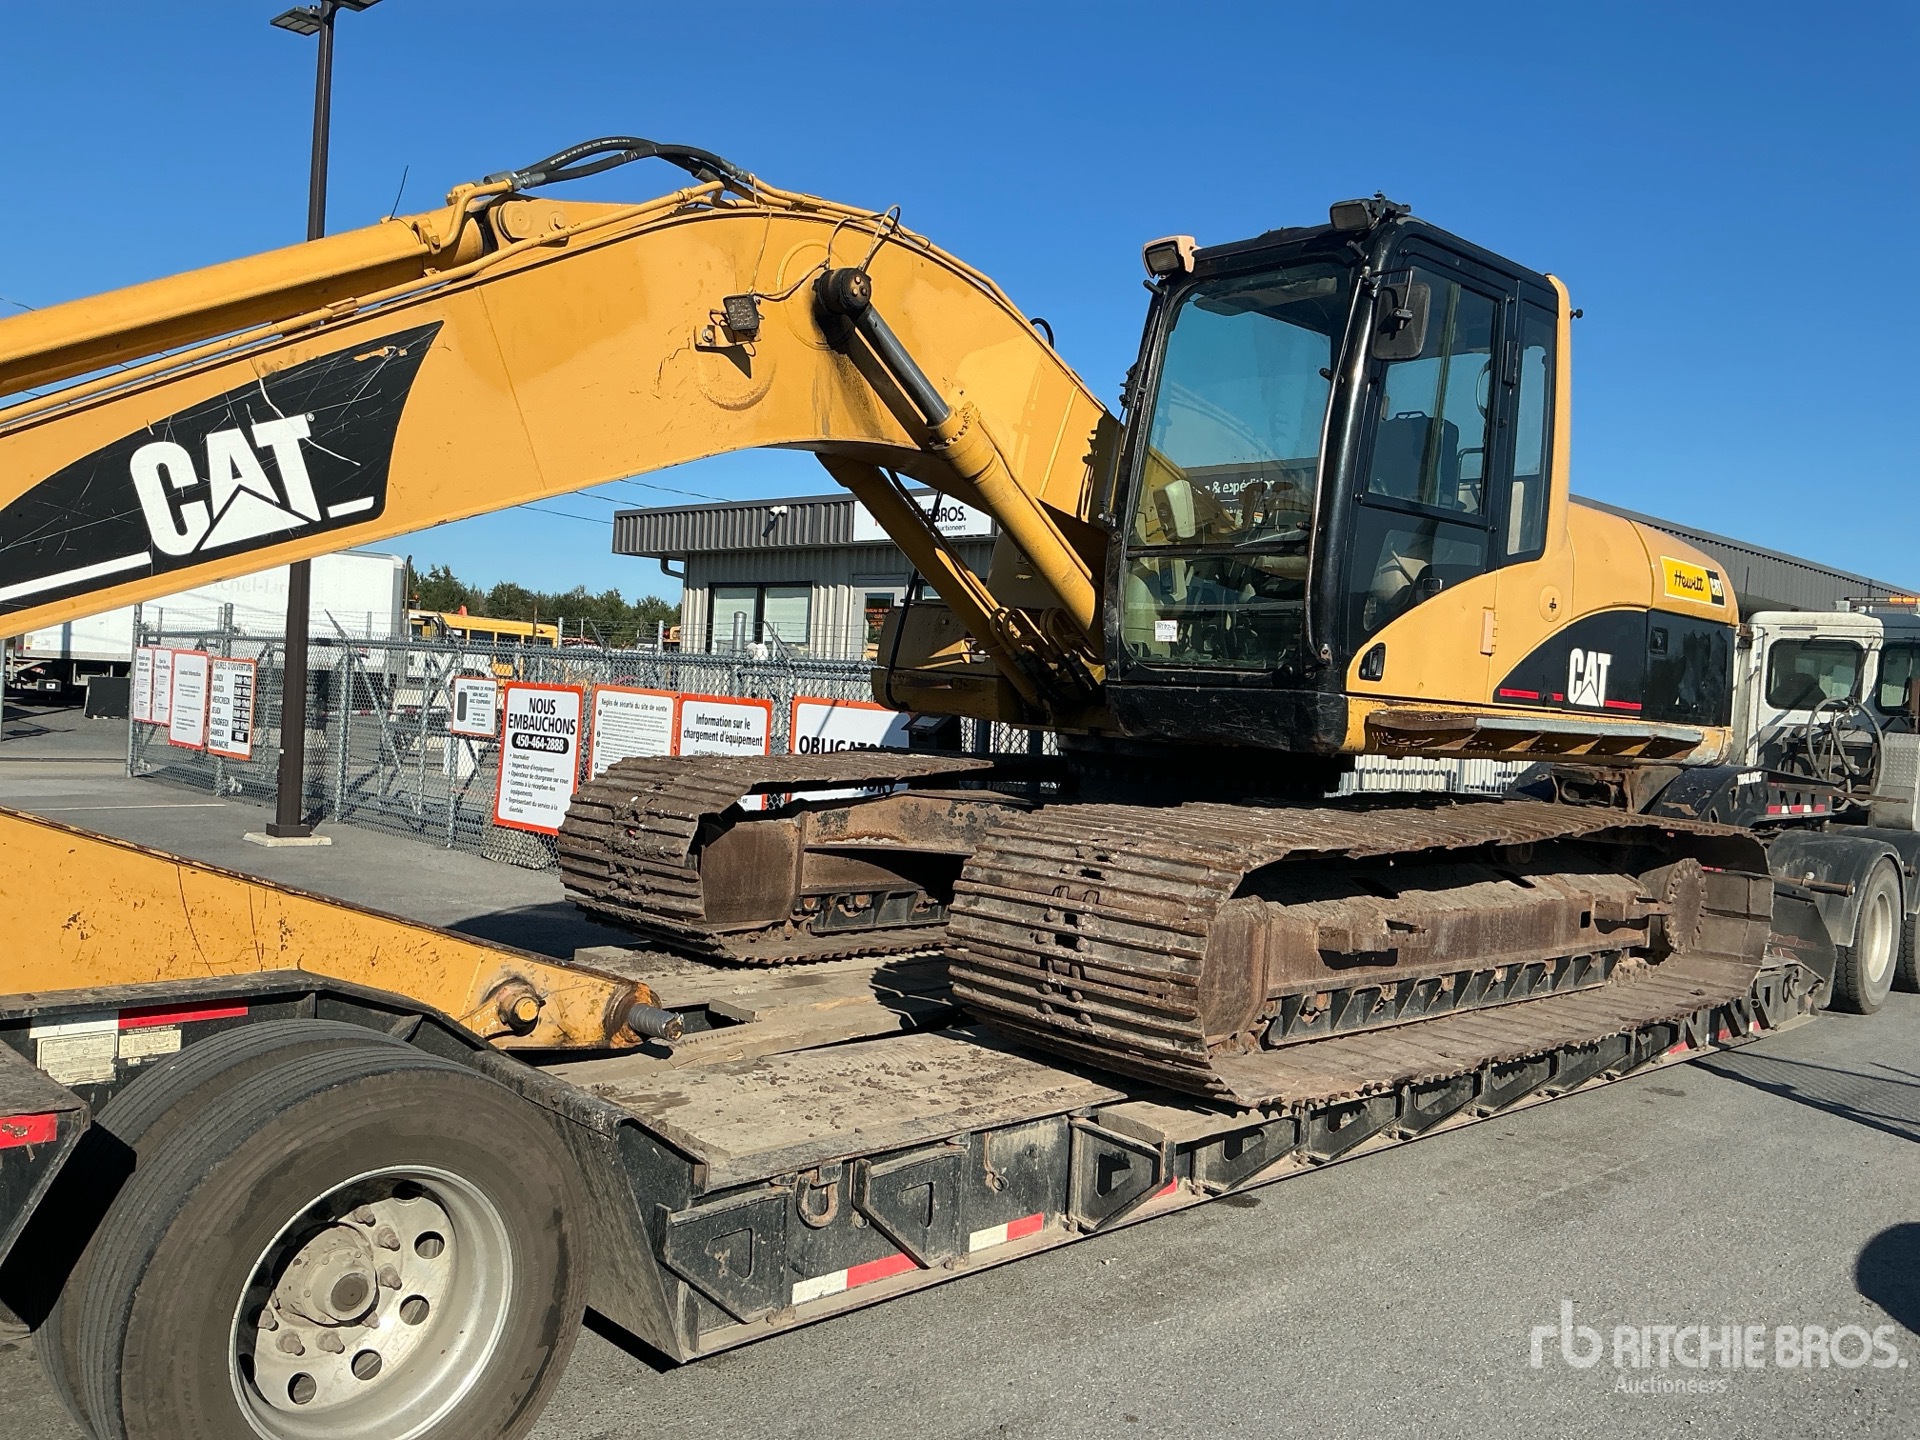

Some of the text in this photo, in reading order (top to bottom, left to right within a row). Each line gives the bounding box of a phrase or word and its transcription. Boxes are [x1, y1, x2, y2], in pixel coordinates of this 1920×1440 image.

[130, 413, 321, 556] CAT
[935, 506, 967, 522] BROS.
[1674, 569, 1704, 591] Hewitt
[1568, 648, 1613, 707] CAT
[529, 697, 556, 715] NOUS
[508, 712, 576, 735] EMBAUCHONS
[695, 713, 751, 730] Information sur le
[515, 734, 564, 751] 450-464-2888
[683, 727, 719, 742] chargement
[720, 730, 763, 747] d'équipement
